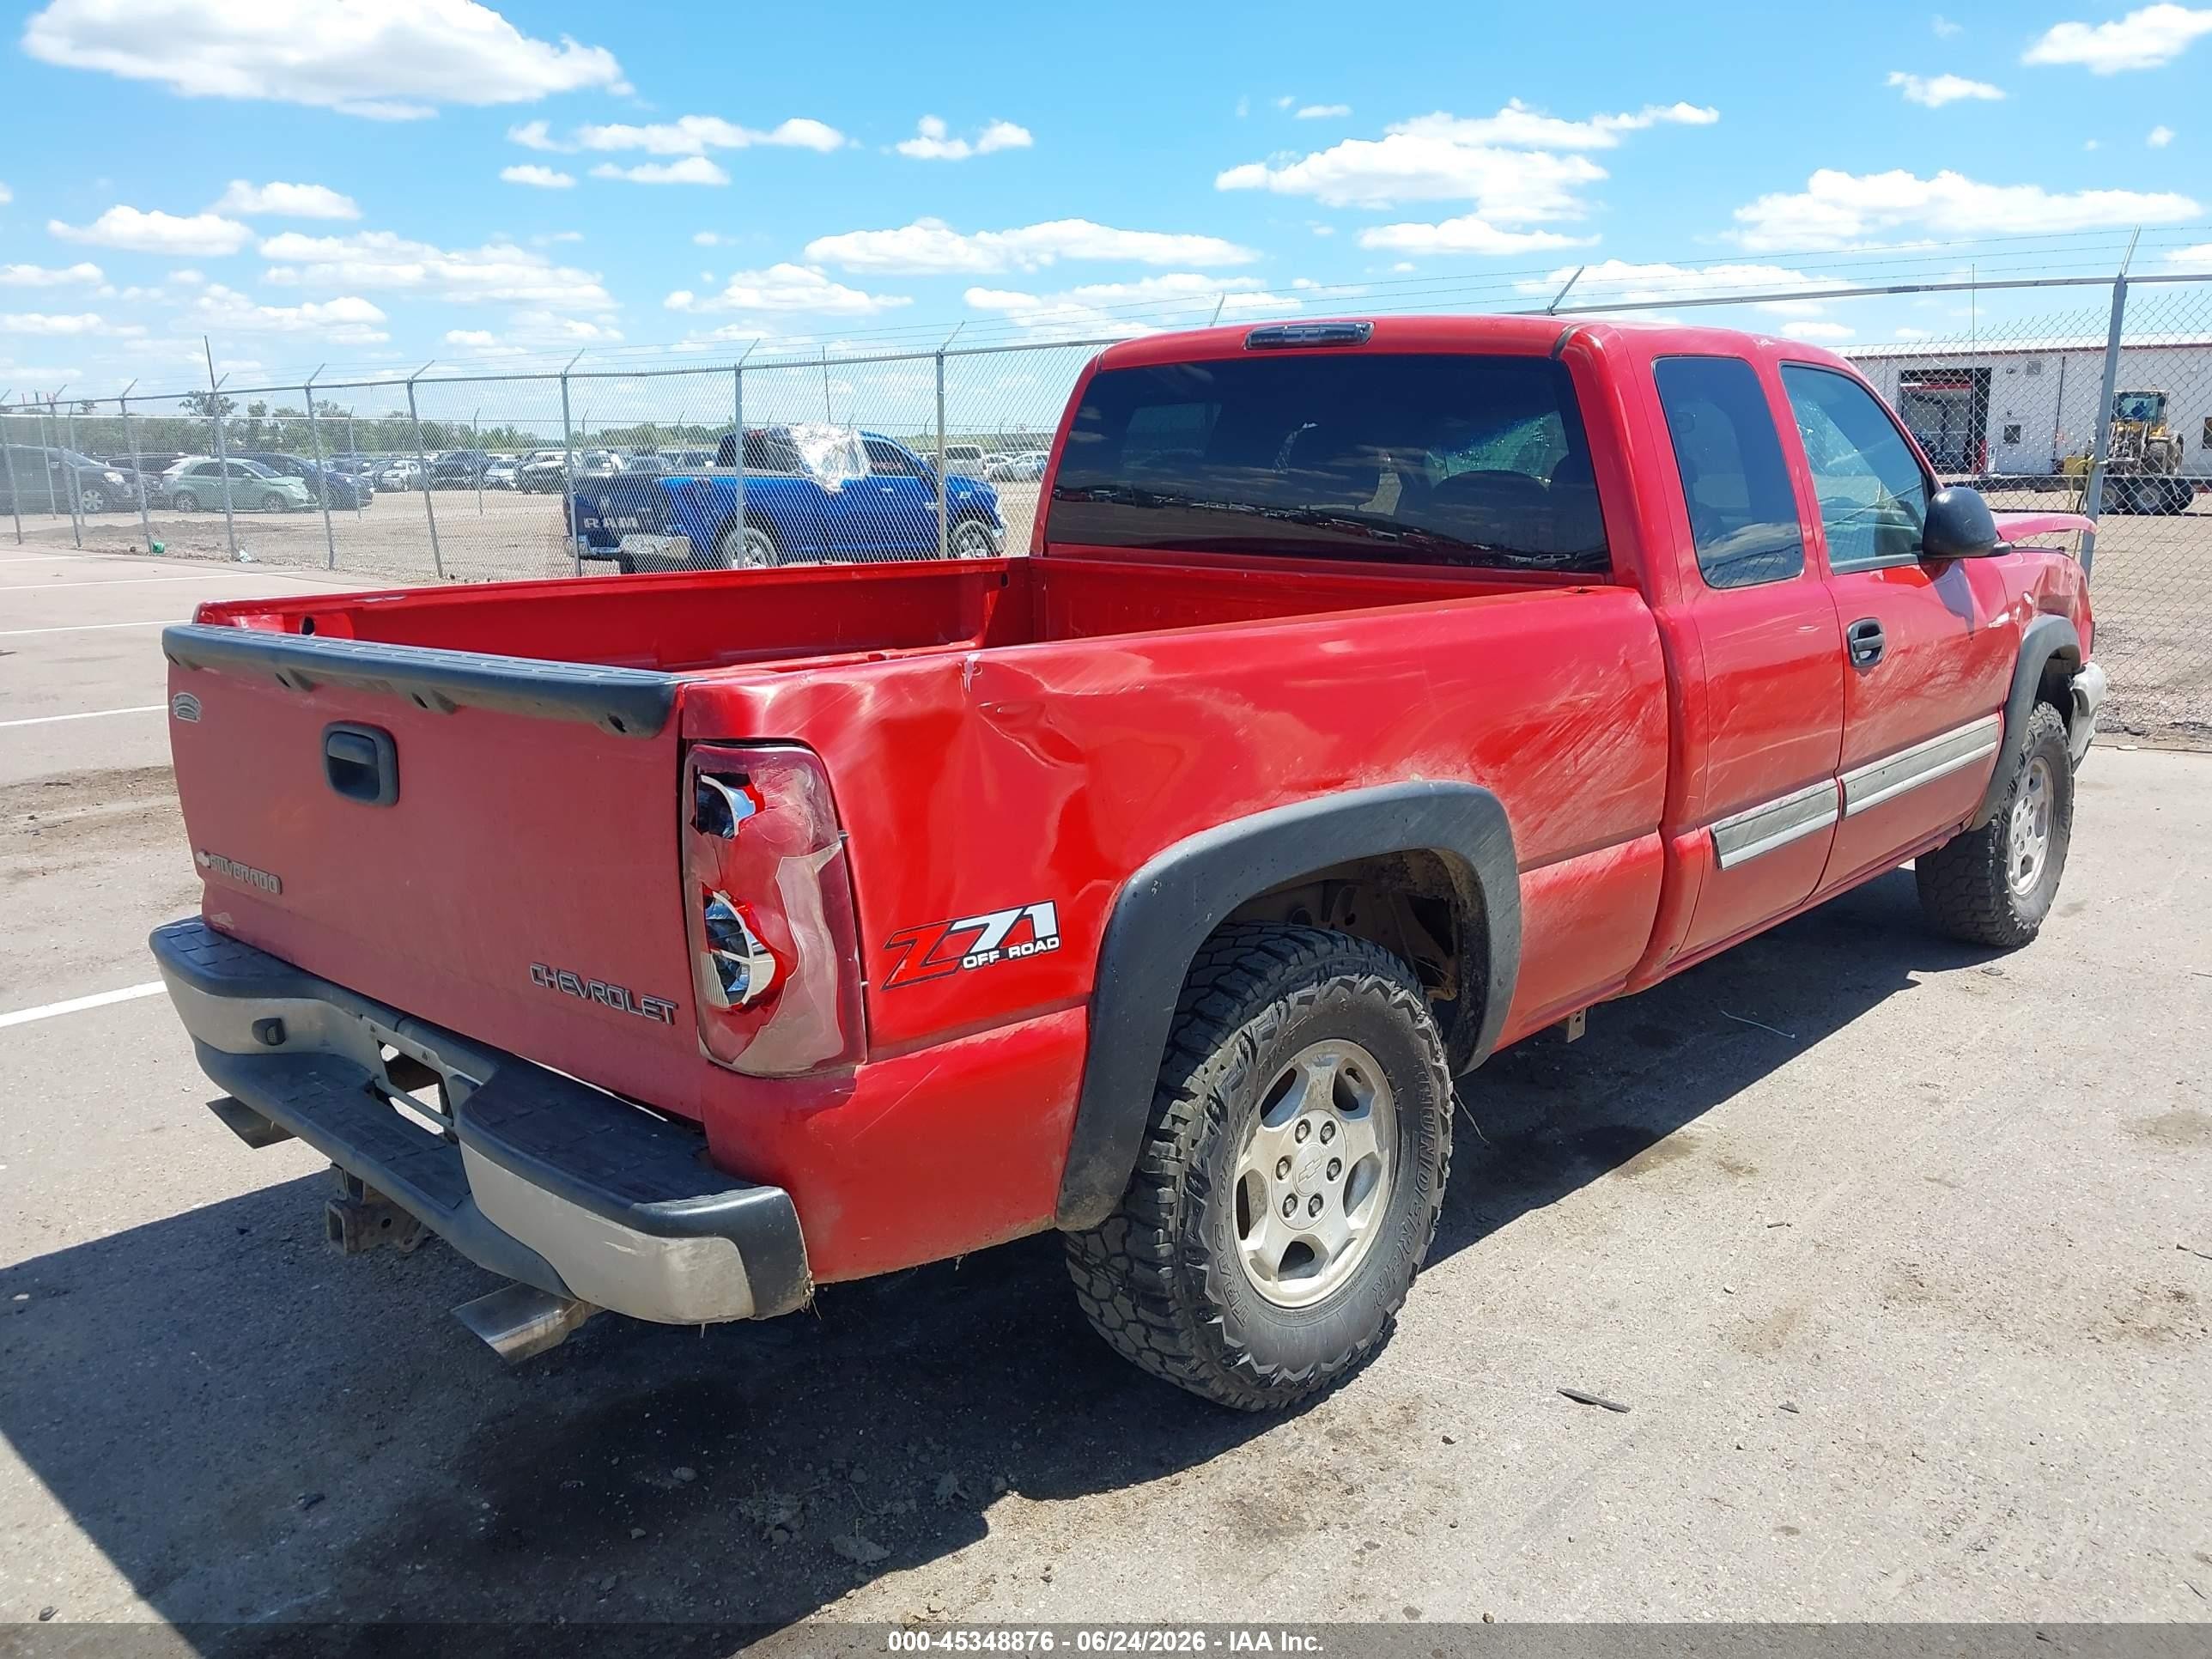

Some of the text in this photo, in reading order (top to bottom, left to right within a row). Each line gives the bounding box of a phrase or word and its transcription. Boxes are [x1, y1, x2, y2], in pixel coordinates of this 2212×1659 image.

[584, 517, 639, 529] RAM
[210, 853, 283, 895] SILVERADO
[879, 900, 1060, 991] Z71
[963, 937, 1060, 969] OFF ROAD
[530, 963, 678, 1025] CHEVROLET
[1214, 1222, 1250, 1328] TRAC
